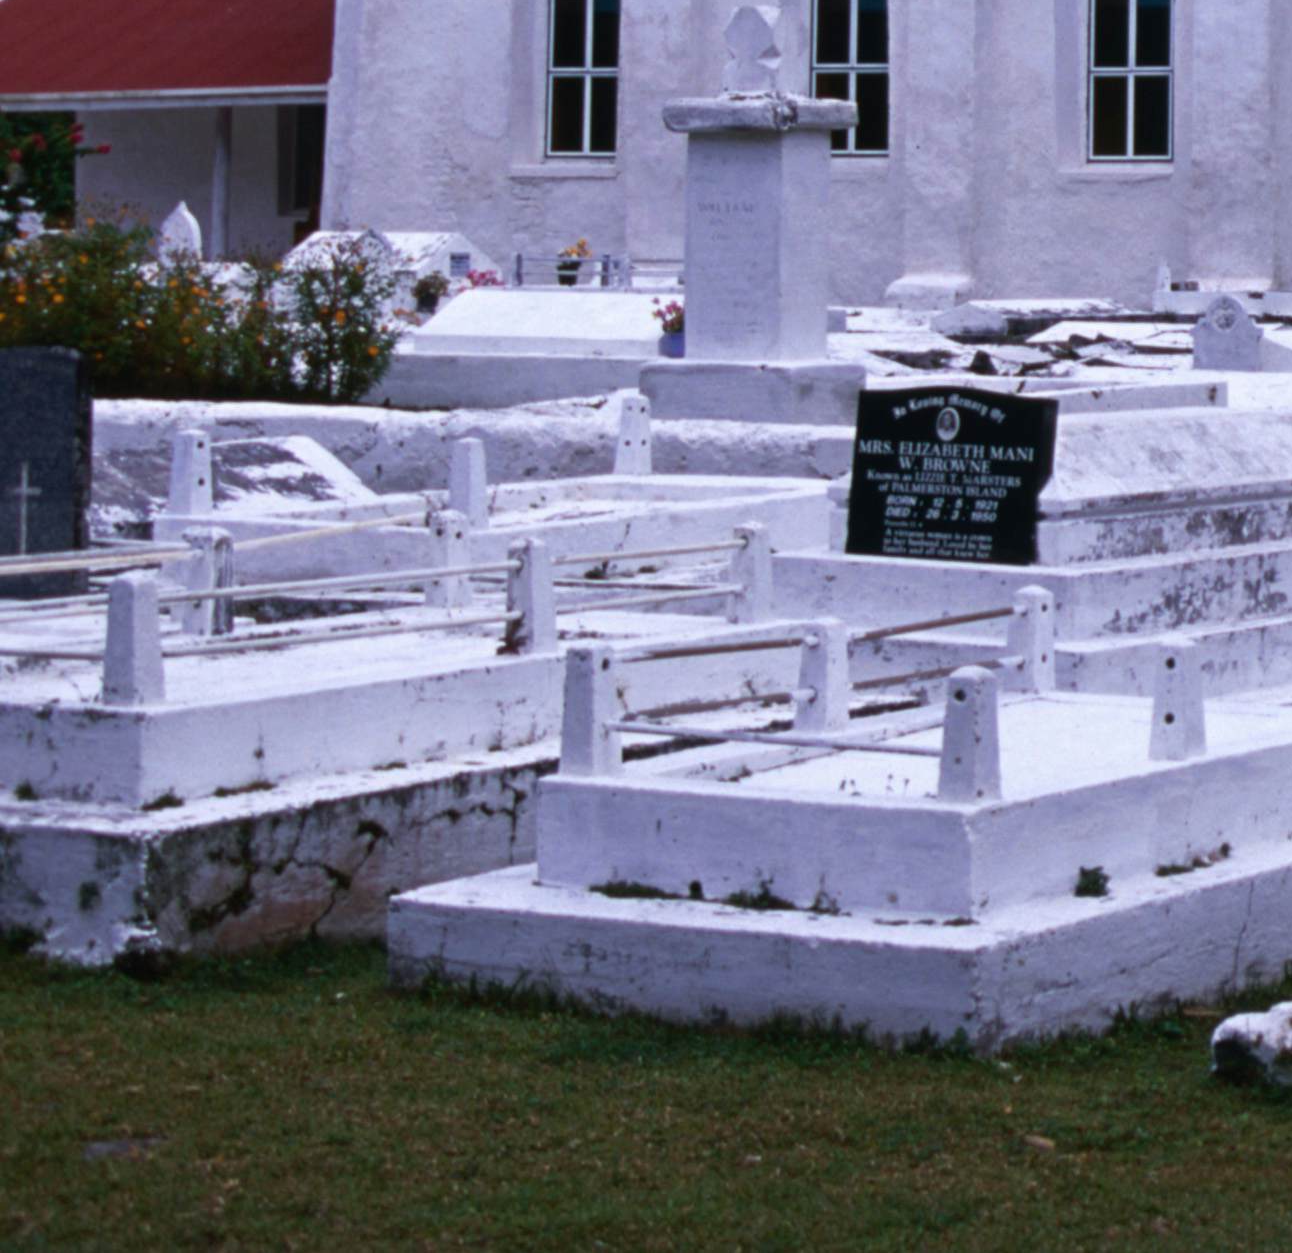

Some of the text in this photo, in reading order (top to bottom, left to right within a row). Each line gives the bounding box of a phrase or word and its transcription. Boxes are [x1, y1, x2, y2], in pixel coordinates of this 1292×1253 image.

[859, 439, 1034, 462] MRS. ELIZABETH MANI
[899, 457, 991, 474] W. BROWNE
[867, 469, 902, 481] Known
[892, 482, 963, 496] PALMERSTON
[966, 485, 1007, 498] ISLAND
